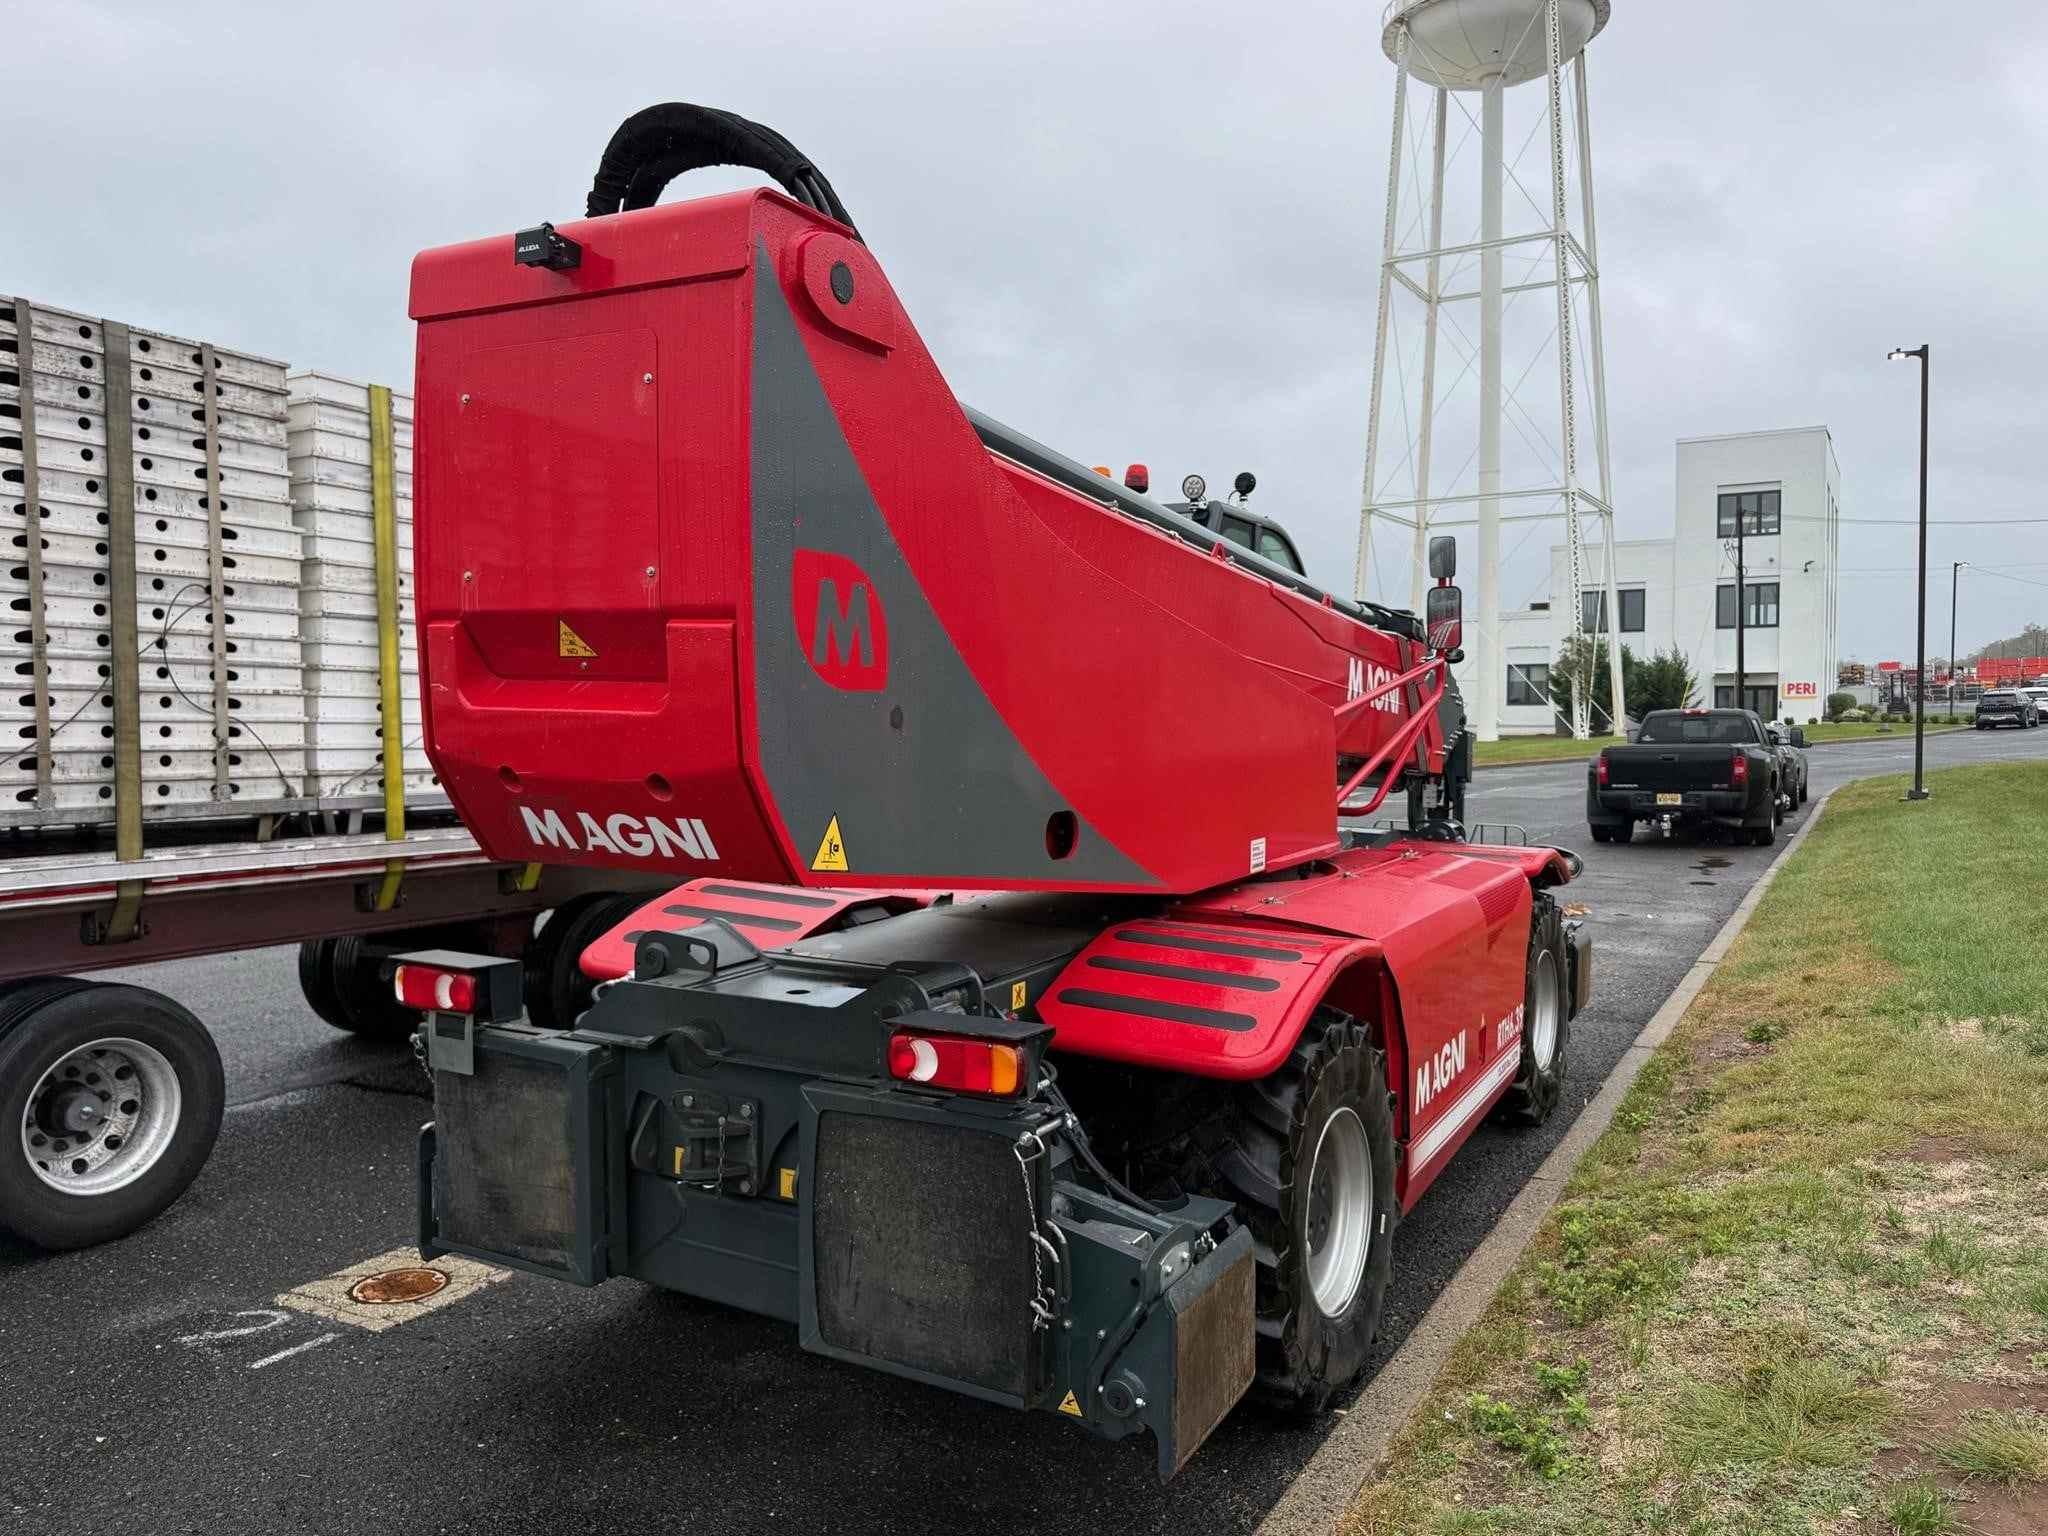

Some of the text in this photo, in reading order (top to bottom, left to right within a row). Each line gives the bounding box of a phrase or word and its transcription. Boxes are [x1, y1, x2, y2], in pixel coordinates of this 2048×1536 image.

[814, 580, 874, 666] M
[1347, 656, 1400, 714] MAGNI
[1786, 682, 1816, 695] PERI
[519, 806, 720, 860] MAGNI
[1415, 1028, 1466, 1115] MAGNI
